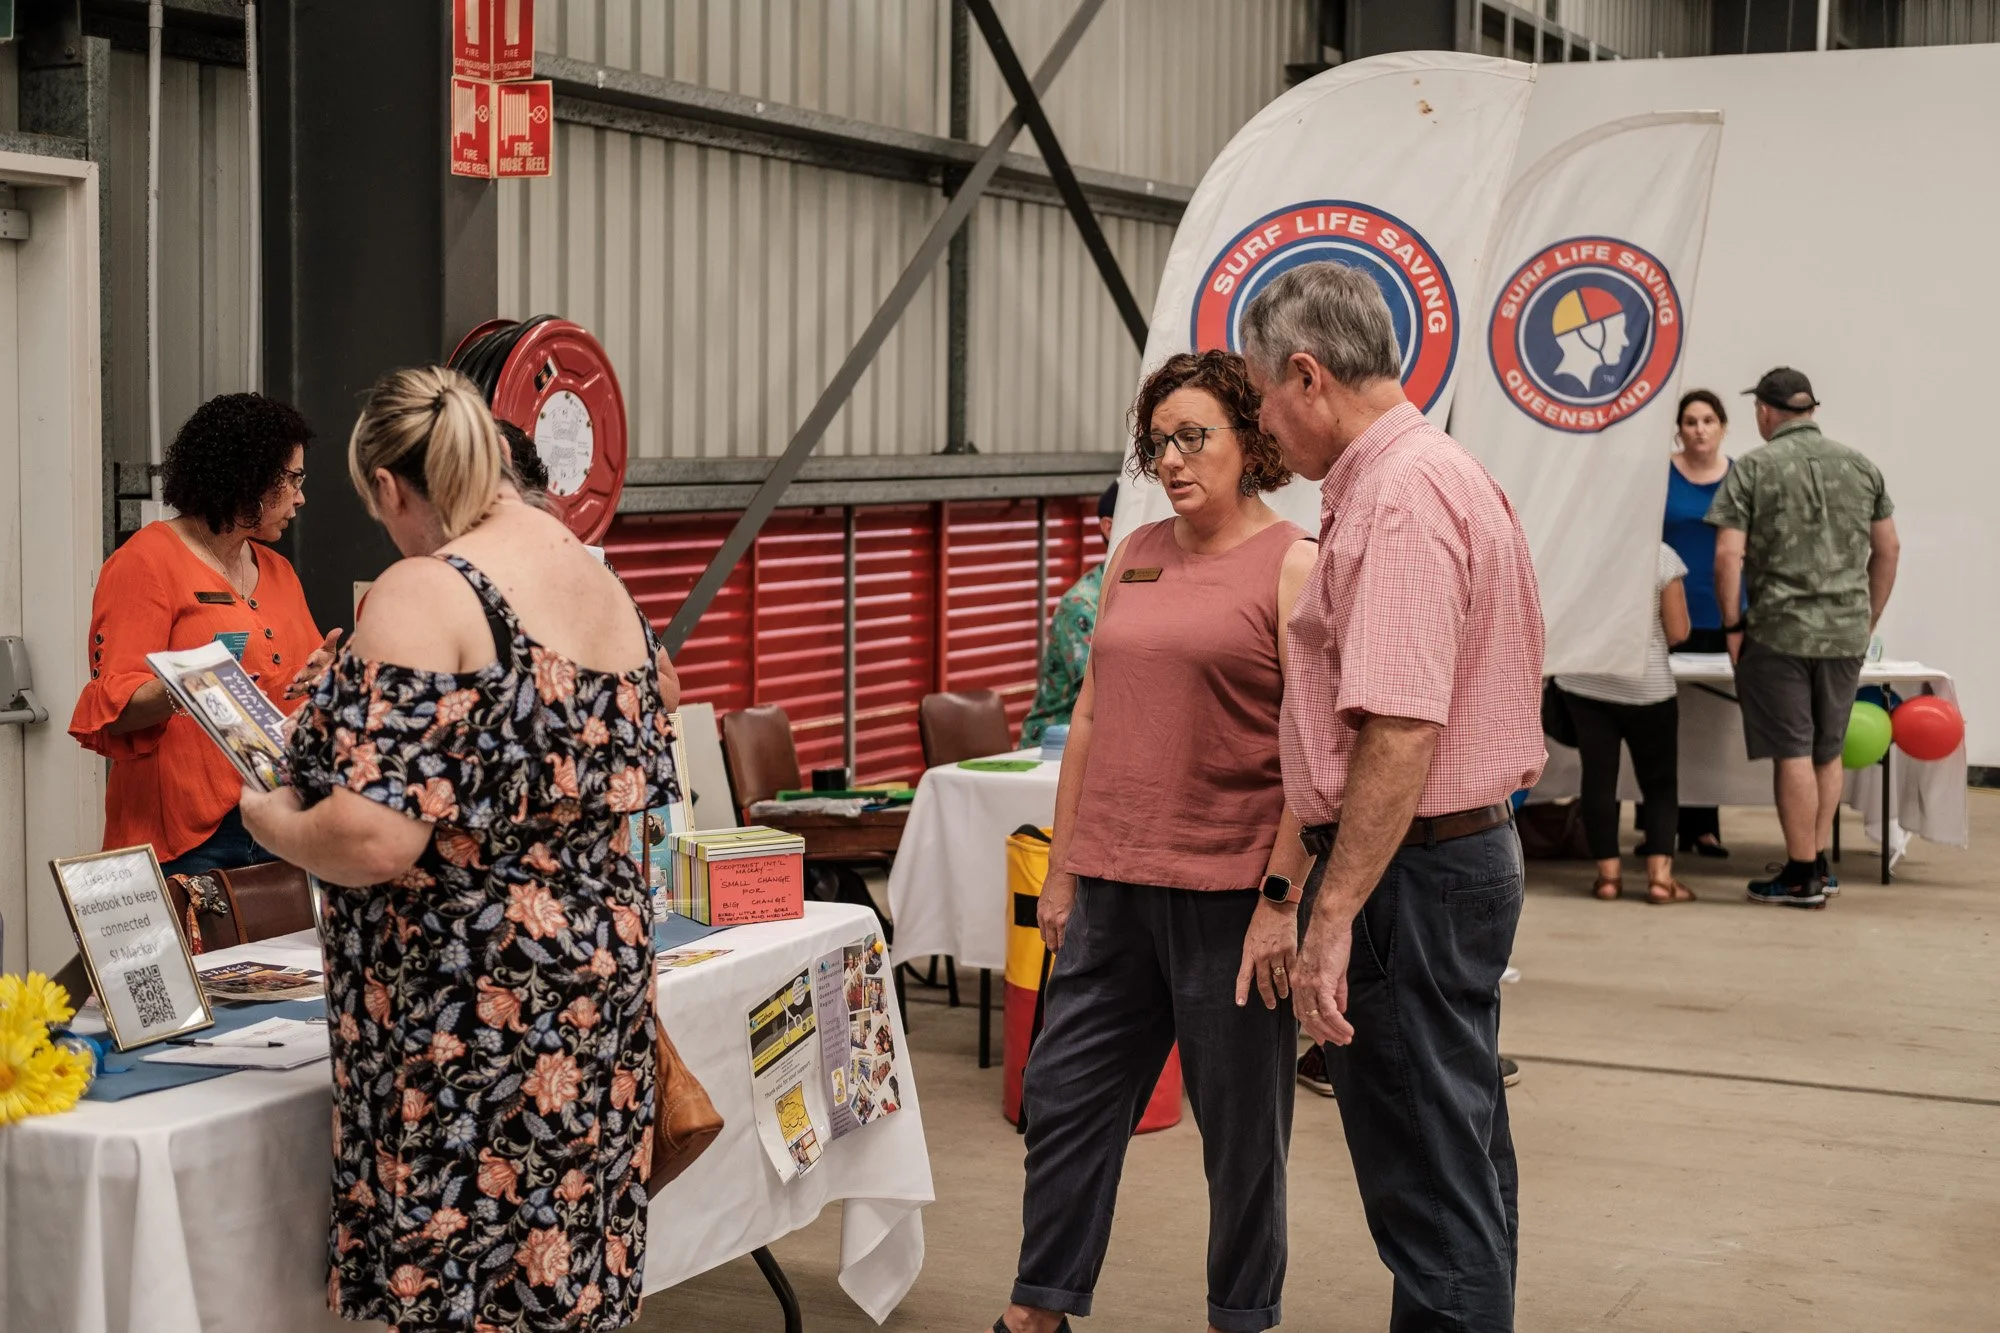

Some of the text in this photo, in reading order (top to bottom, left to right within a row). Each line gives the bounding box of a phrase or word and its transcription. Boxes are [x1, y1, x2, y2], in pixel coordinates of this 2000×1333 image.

[465, 47, 480, 58] FIRE
[503, 48, 519, 58] FIRE
[455, 58, 490, 71] EXTINGUISHER
[494, 60, 531, 72] EXTINGUISHER
[463, 148, 478, 160] FIRE
[514, 141, 534, 156] FIRE
[453, 160, 489, 176] HOSE REEL
[500, 156, 546, 172] HOSE REEL
[1213, 212, 1447, 335] SURF LIFE SAVING
[1501, 245, 1674, 326] SURF LIFE SAVING
[1506, 368, 1651, 427] QUEENSLAND
[232, 671, 265, 709] WHAT
[118, 868, 132, 880] on
[736, 866, 764, 874] MACKAY
[758, 876, 791, 884] CHANGE
[74, 889, 158, 917] Facebook to keep
[722, 901, 740, 909] BIG
[100, 913, 150, 937] connected
[834, 1070, 844, 1103] 3
